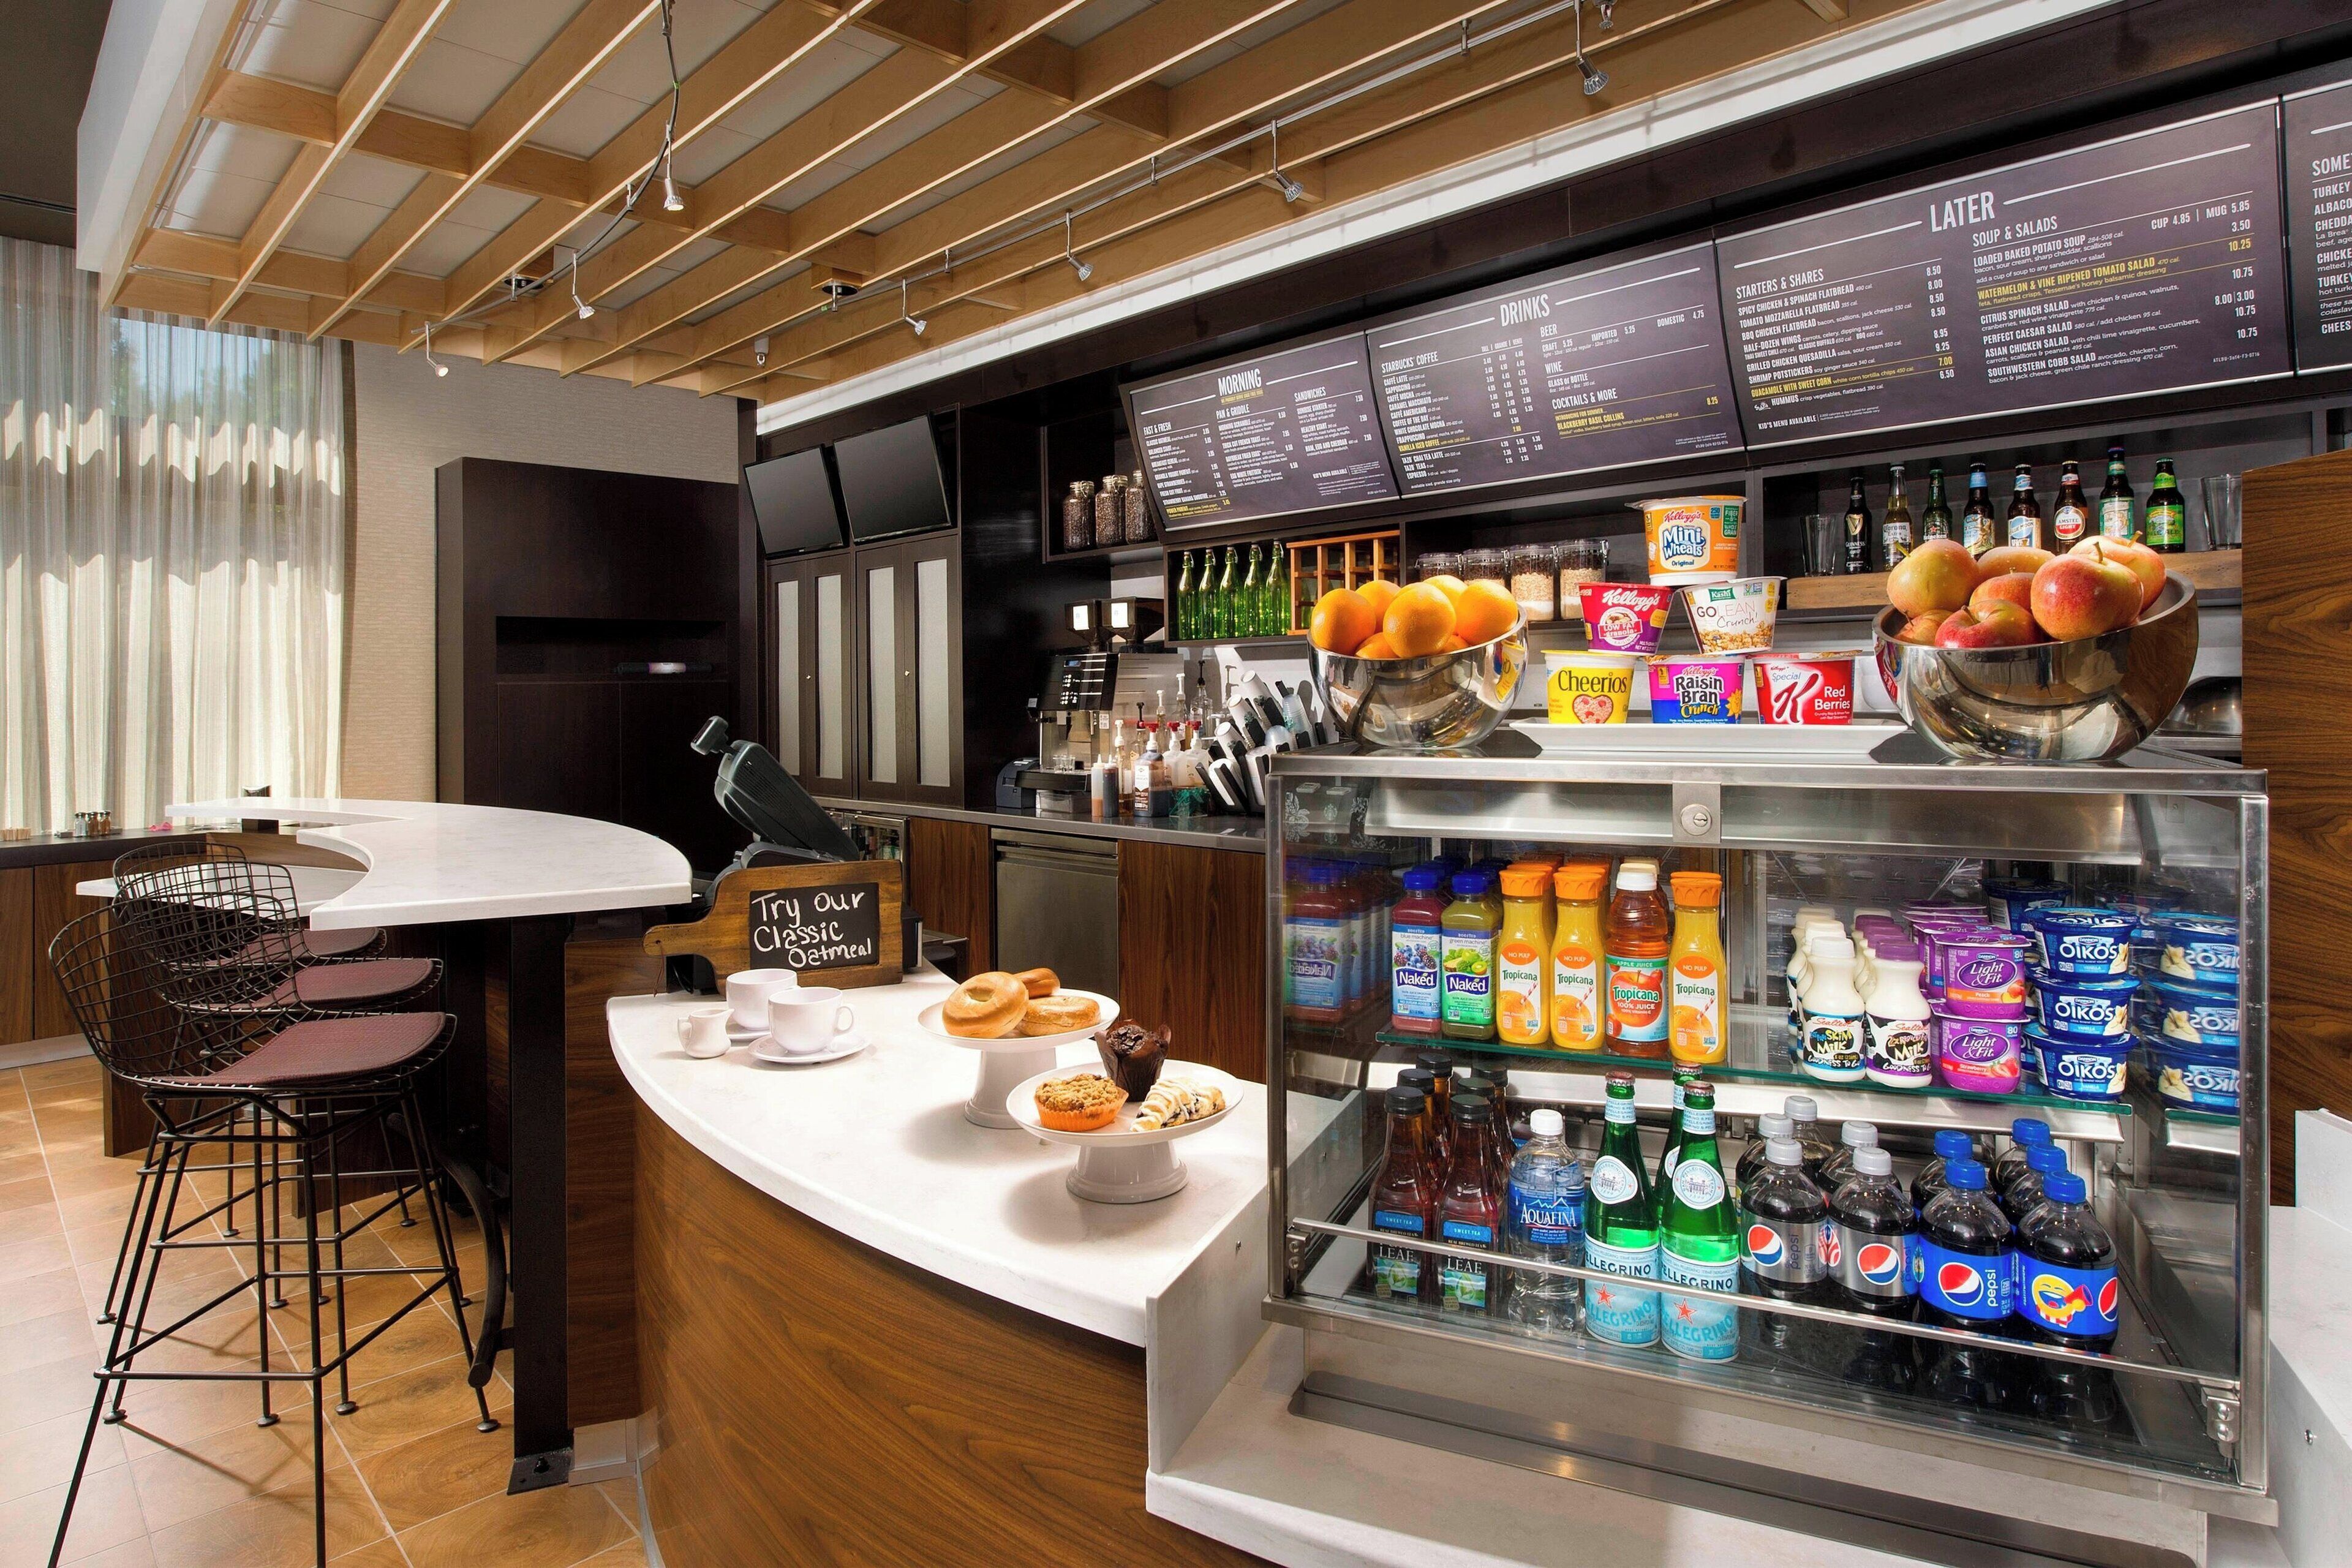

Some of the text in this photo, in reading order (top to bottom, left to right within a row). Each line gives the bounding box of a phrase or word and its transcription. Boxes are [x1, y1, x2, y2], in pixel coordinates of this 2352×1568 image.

[2312, 153, 2352, 176] SOME
[2312, 181, 2350, 199] TURKEY
[1930, 191, 1995, 232] LATER
[2151, 200, 2249, 230] CUP 4.85 MUG 5.85
[1973, 216, 2057, 246] SOUP & SALADS
[2232, 219, 2250, 232] 3.50
[1973, 235, 2086, 267] LOADED BAKED POTATO SOUP
[2229, 238, 2251, 251] 10.25
[1978, 284, 2028, 300] WATERMELON
[2038, 277, 2056, 288] VINE
[2058, 270, 2090, 284] RIPENED
[2092, 263, 2125, 277] TOMATO
[2127, 257, 2155, 271] SALAD
[2232, 266, 2253, 279] 10.75
[1736, 269, 1824, 299] STARTERS & SHARES
[1738, 307, 1755, 315] SPICY
[1757, 300, 1782, 312] CHICKEN
[1790, 292, 1817, 305] SPINACH
[1819, 284, 1854, 299] FLATBREAD
[1500, 294, 1550, 326] DRINKS
[1740, 301, 1840, 328] TOMATO MOZZARELLA FLATBREAD
[1540, 324, 1557, 337] BEER
[1542, 310, 1704, 352] CRAFT 5.25 IMPORTED 5.25 DOMESTIC 4.75
[1936, 342, 1950, 352] 9.25
[1985, 336, 2068, 358] ASIAN CHICKEN SALAD
[1416, 351, 1438, 365] COFFEE
[1747, 349, 1836, 372] GRILLED CHICKEN QUESADILLA
[1988, 352, 2096, 377] SOUTHWESTERN COBB SALAD
[1545, 361, 1563, 374] WINE
[1218, 368, 1262, 396] MORNING
[1295, 386, 1327, 402] SANDWICHES
[1552, 388, 1618, 410] COCKTAILS & MORE
[1706, 396, 1719, 405] 8.25
[1771, 395, 1799, 405] HUMMUS
[1216, 409, 1225, 420] PAN
[1231, 404, 1250, 417] GRIDDLE
[1144, 425, 1153, 435] FAST
[1160, 422, 1171, 431] FRESH
[1664, 510, 1702, 522] Kellogg's
[1663, 526, 1702, 546] Mini
[1664, 543, 1703, 560] Wheats
[1602, 588, 1660, 611] Kellogg's
[1683, 666, 1716, 676] Kellogg's
[1772, 673, 1801, 682] Special
[1558, 670, 1627, 693] Cheerios
[1676, 676, 1722, 692] Raisin
[1681, 691, 1717, 706] Bran
[1774, 673, 1819, 723] K
[1825, 685, 1845, 698] Red
[1681, 704, 1718, 718] Crunch
[1815, 698, 1850, 710] Berries
[752, 892, 800, 929] Try
[754, 922, 843, 952] Classic
[788, 938, 871, 968] Oatmeal
[1502, 970, 1537, 981] Tropicana
[1970, 962, 2004, 976] Light
[1400, 971, 1434, 986] Naked
[1450, 976, 1487, 992] Naked
[1557, 973, 1594, 986] Tropicana
[1613, 986, 1659, 1001] Tropicana
[1676, 984, 1715, 996] Tropicana
[1962, 1036, 1997, 1049] Light
[1520, 1203, 1577, 1227] AQUAFINA
[1985, 1269, 1998, 1306] pepsi
